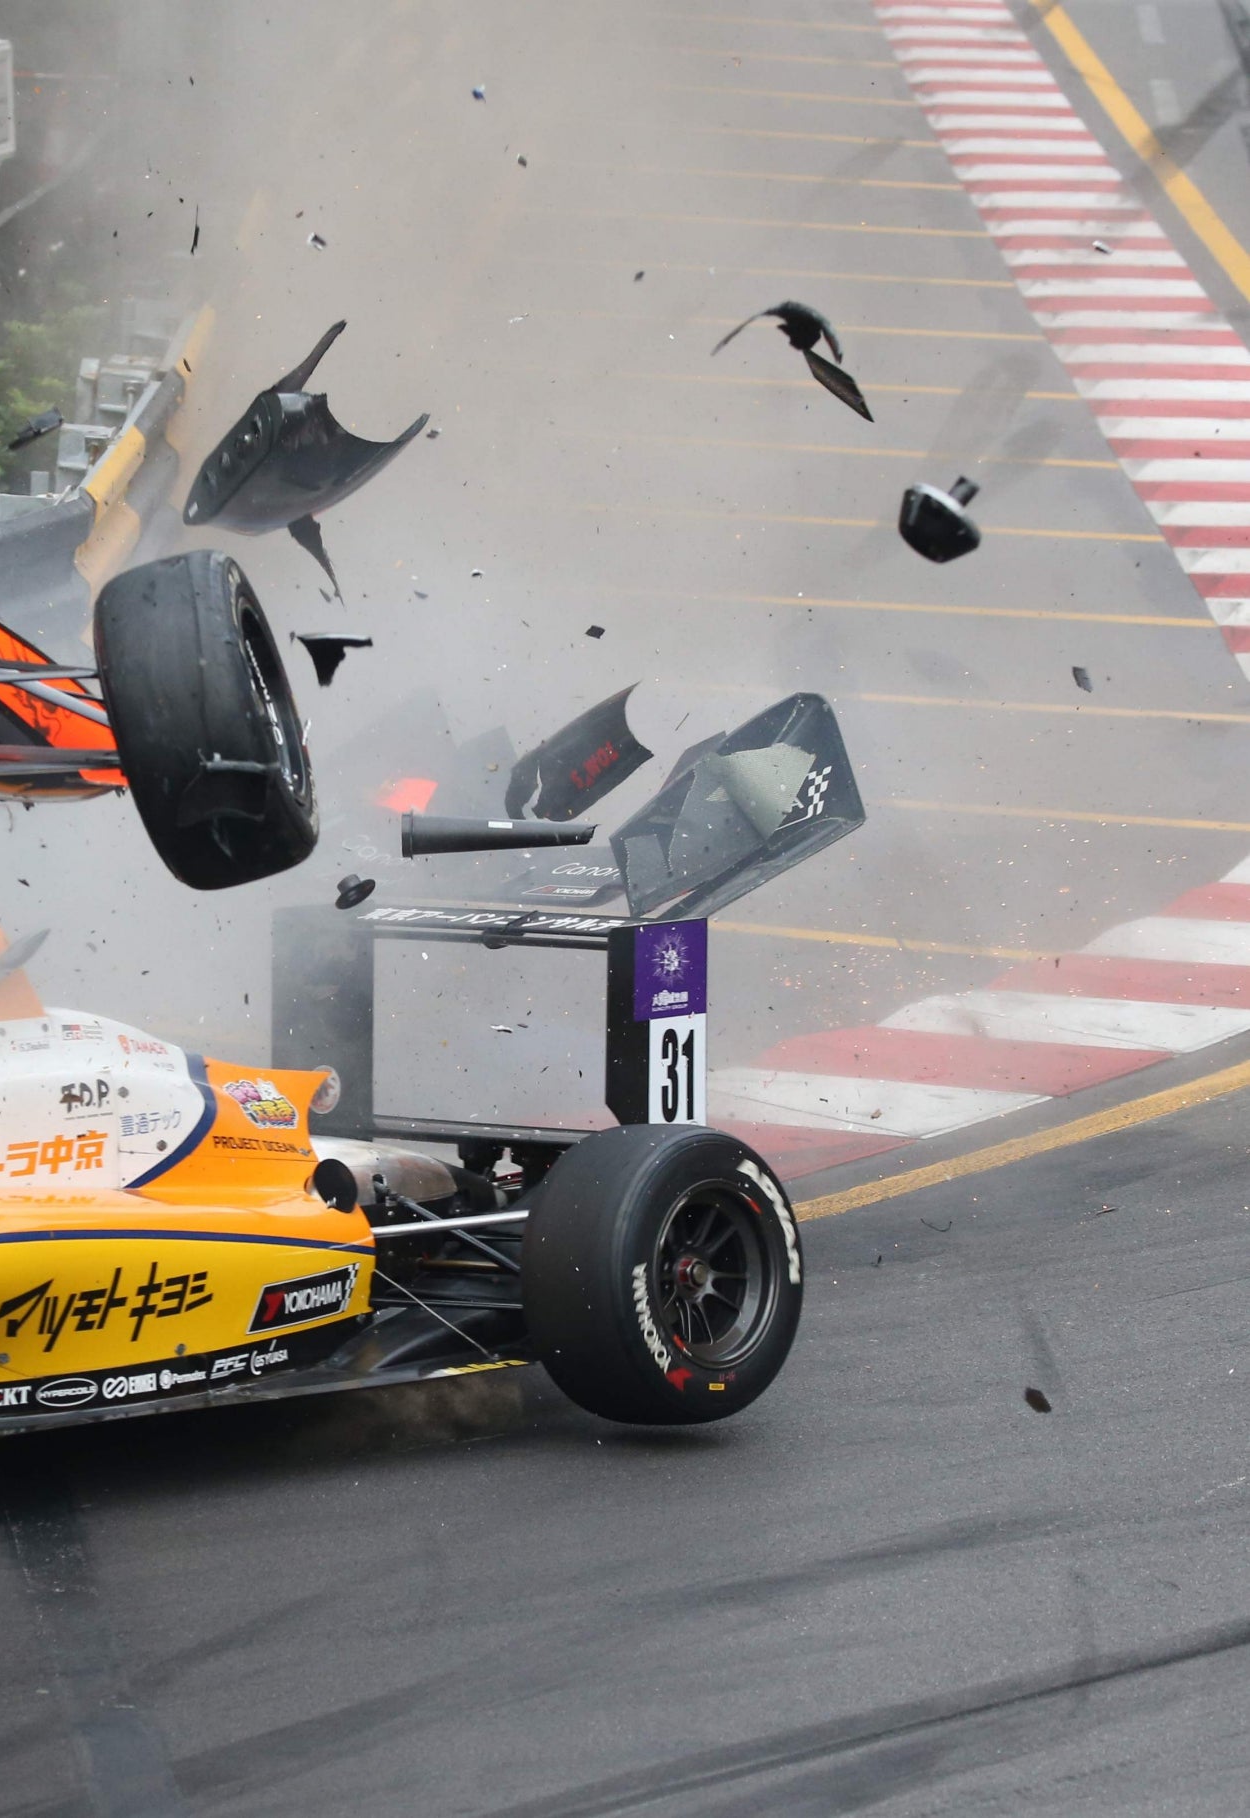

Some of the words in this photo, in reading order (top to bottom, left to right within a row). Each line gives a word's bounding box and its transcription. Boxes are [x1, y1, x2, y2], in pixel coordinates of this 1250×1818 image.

[661, 1028, 695, 1123] 31
[212, 1136, 260, 1151] PROJECT
[262, 1140, 300, 1153] OCEAN
[736, 1158, 800, 1284] ADVAN
[284, 1280, 343, 1314] YOKOHAMA
[632, 1262, 671, 1375] YOKOHAMA
[212, 1353, 250, 1373] PFC
